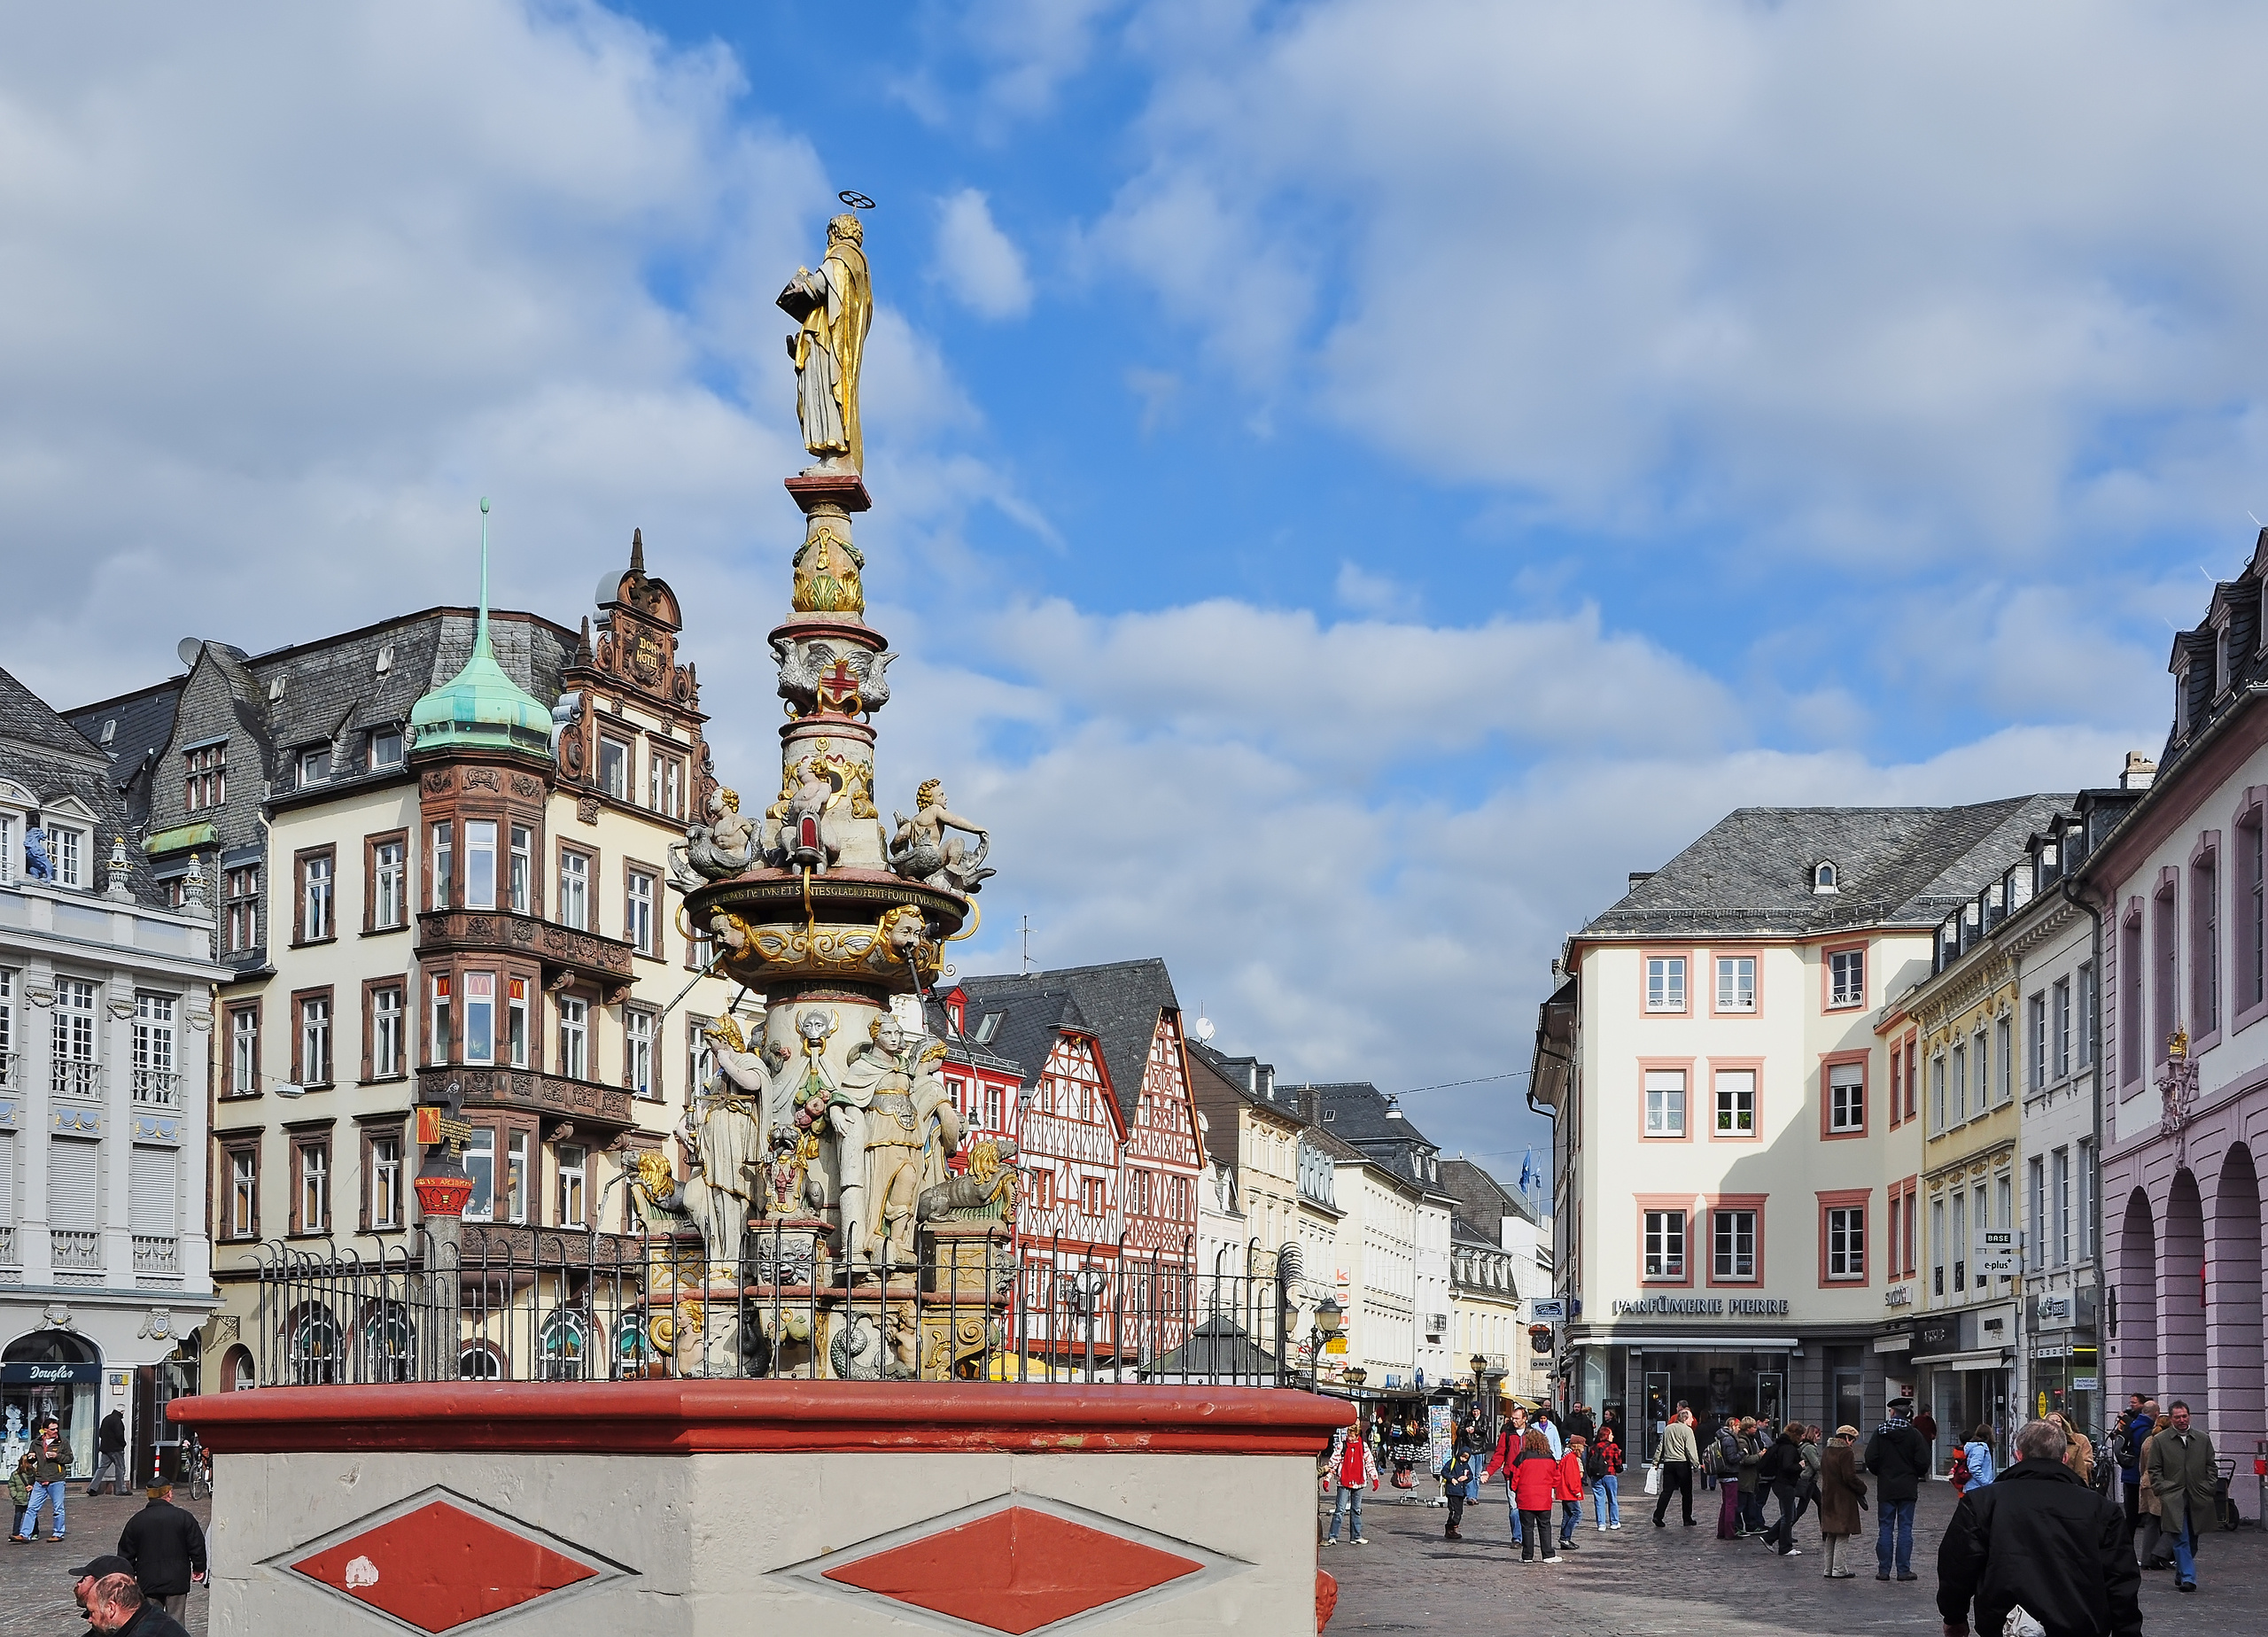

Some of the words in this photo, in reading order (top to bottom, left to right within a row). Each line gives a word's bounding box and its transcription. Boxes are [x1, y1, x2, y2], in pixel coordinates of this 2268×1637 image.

[636, 650, 657, 669] HOTEL
[1614, 1295, 1724, 1314] PARFÜMERIE
[1728, 1299, 1790, 1314] PIERRE
[30, 1365, 74, 1381] Douglas
